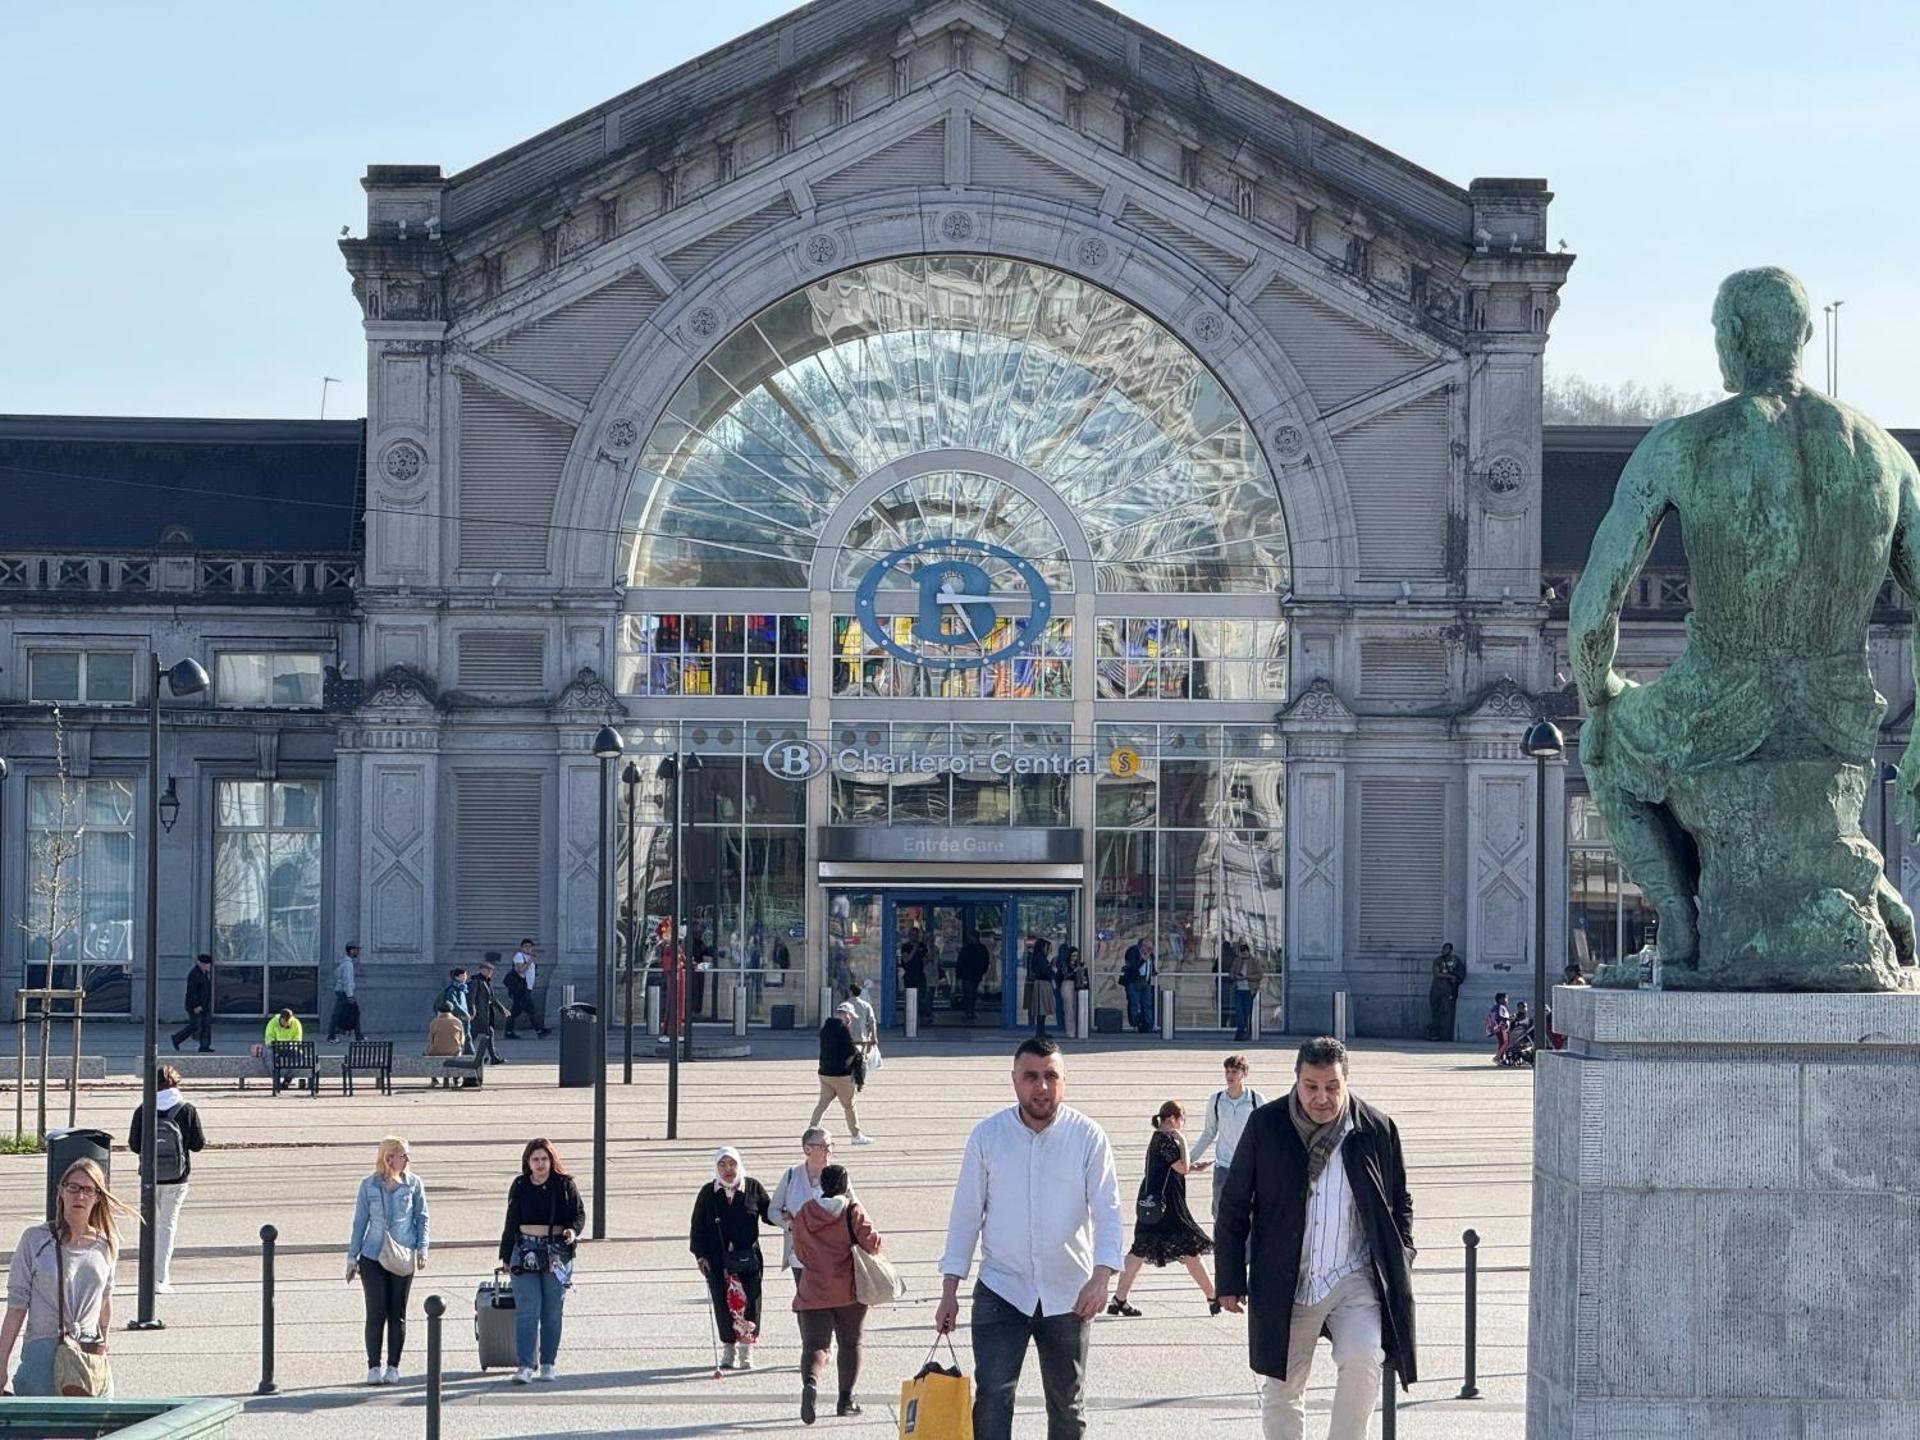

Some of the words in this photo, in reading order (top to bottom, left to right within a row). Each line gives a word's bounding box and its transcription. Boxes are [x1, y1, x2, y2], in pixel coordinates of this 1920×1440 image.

[838, 748, 1098, 774] Charleroi-Central
[903, 835, 960, 853] Entrée
[963, 837, 1005, 853] Gare
